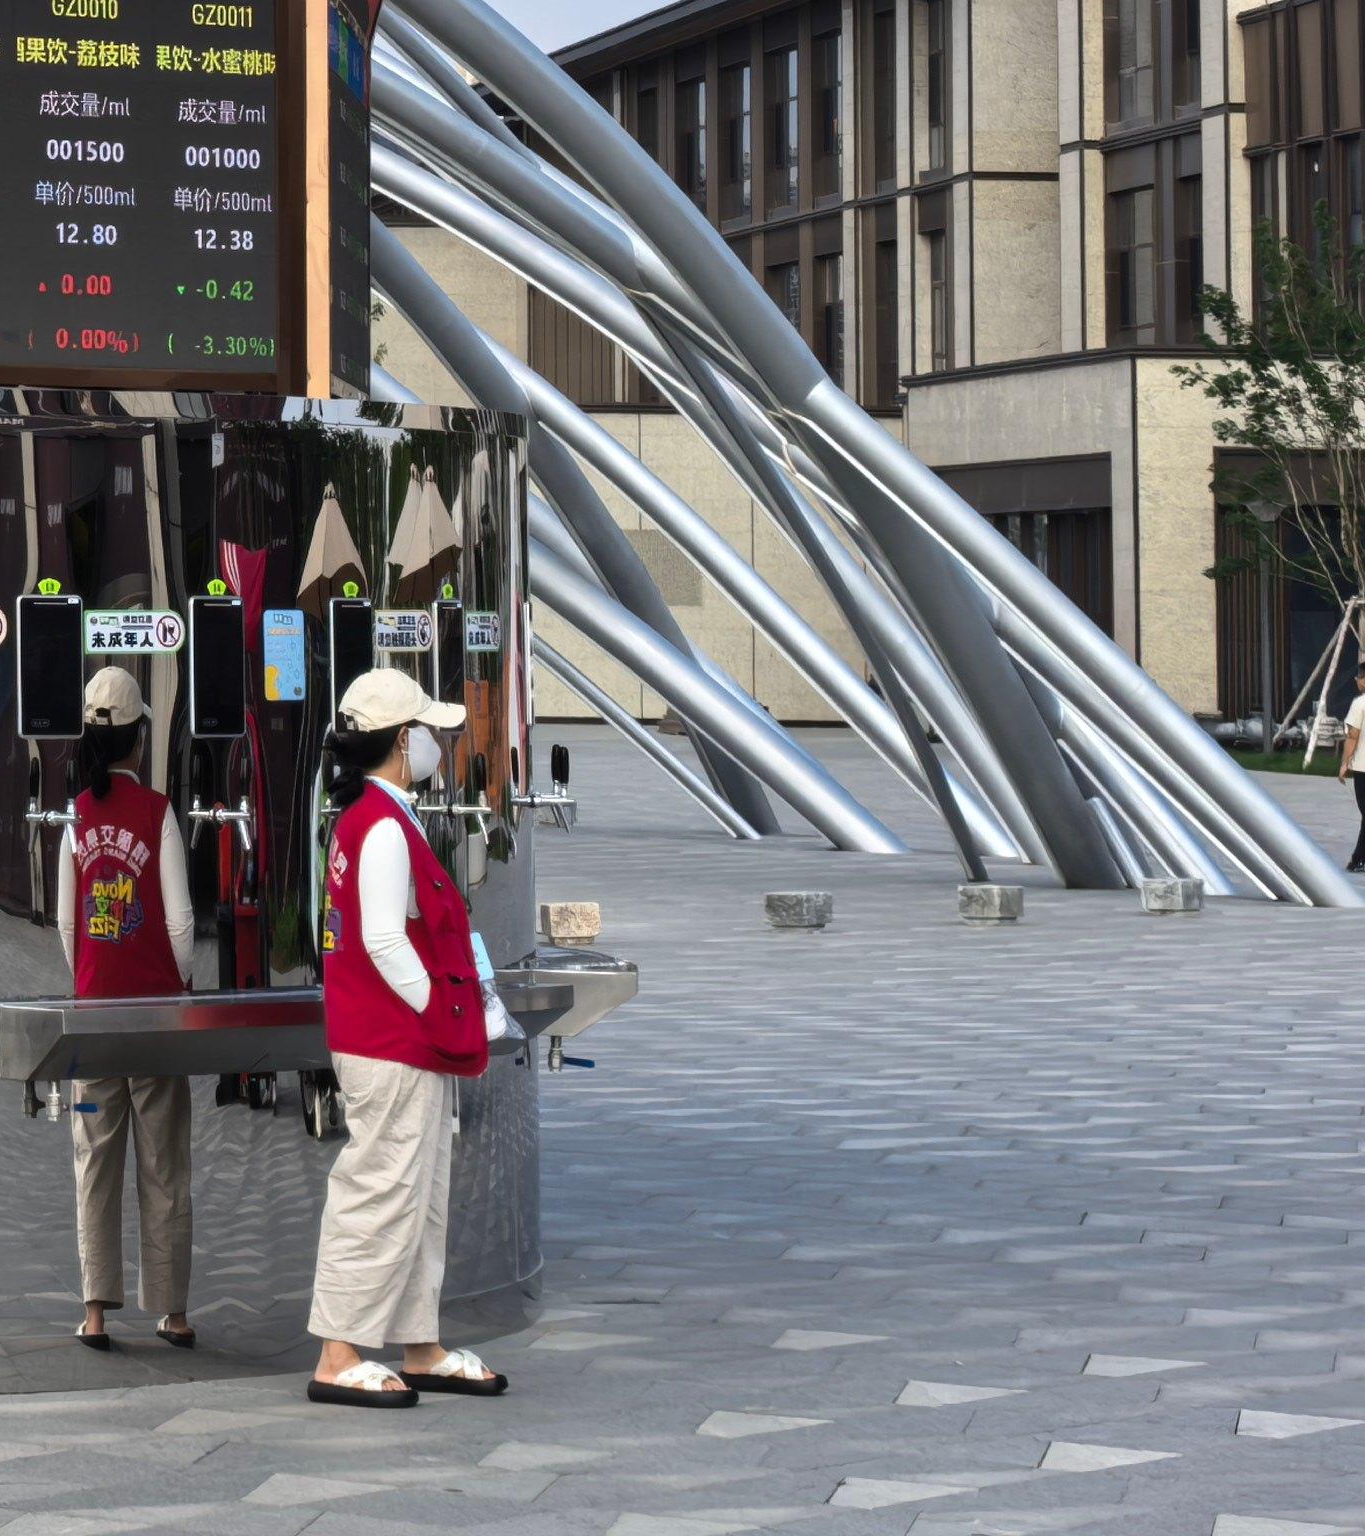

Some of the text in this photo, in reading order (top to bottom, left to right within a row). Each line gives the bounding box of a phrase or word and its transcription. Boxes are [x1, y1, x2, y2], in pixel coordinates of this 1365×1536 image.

[192, 3, 253, 28] GZ0011
[39, 90, 130, 118] 成交量/ml
[178, 98, 266, 125] 成交量/ml
[46, 138, 125, 163] 001500
[185, 145, 261, 170] 001000
[34, 179, 135, 206] 单价/500ml
[173, 186, 273, 213] 单价/500ml
[55, 222, 118, 246] 12.80
[194, 228, 254, 251] 12.38
[61, 273, 112, 296] 0.00
[196, 279, 254, 302] -0.42
[91, 631, 154, 648] 未成年人
